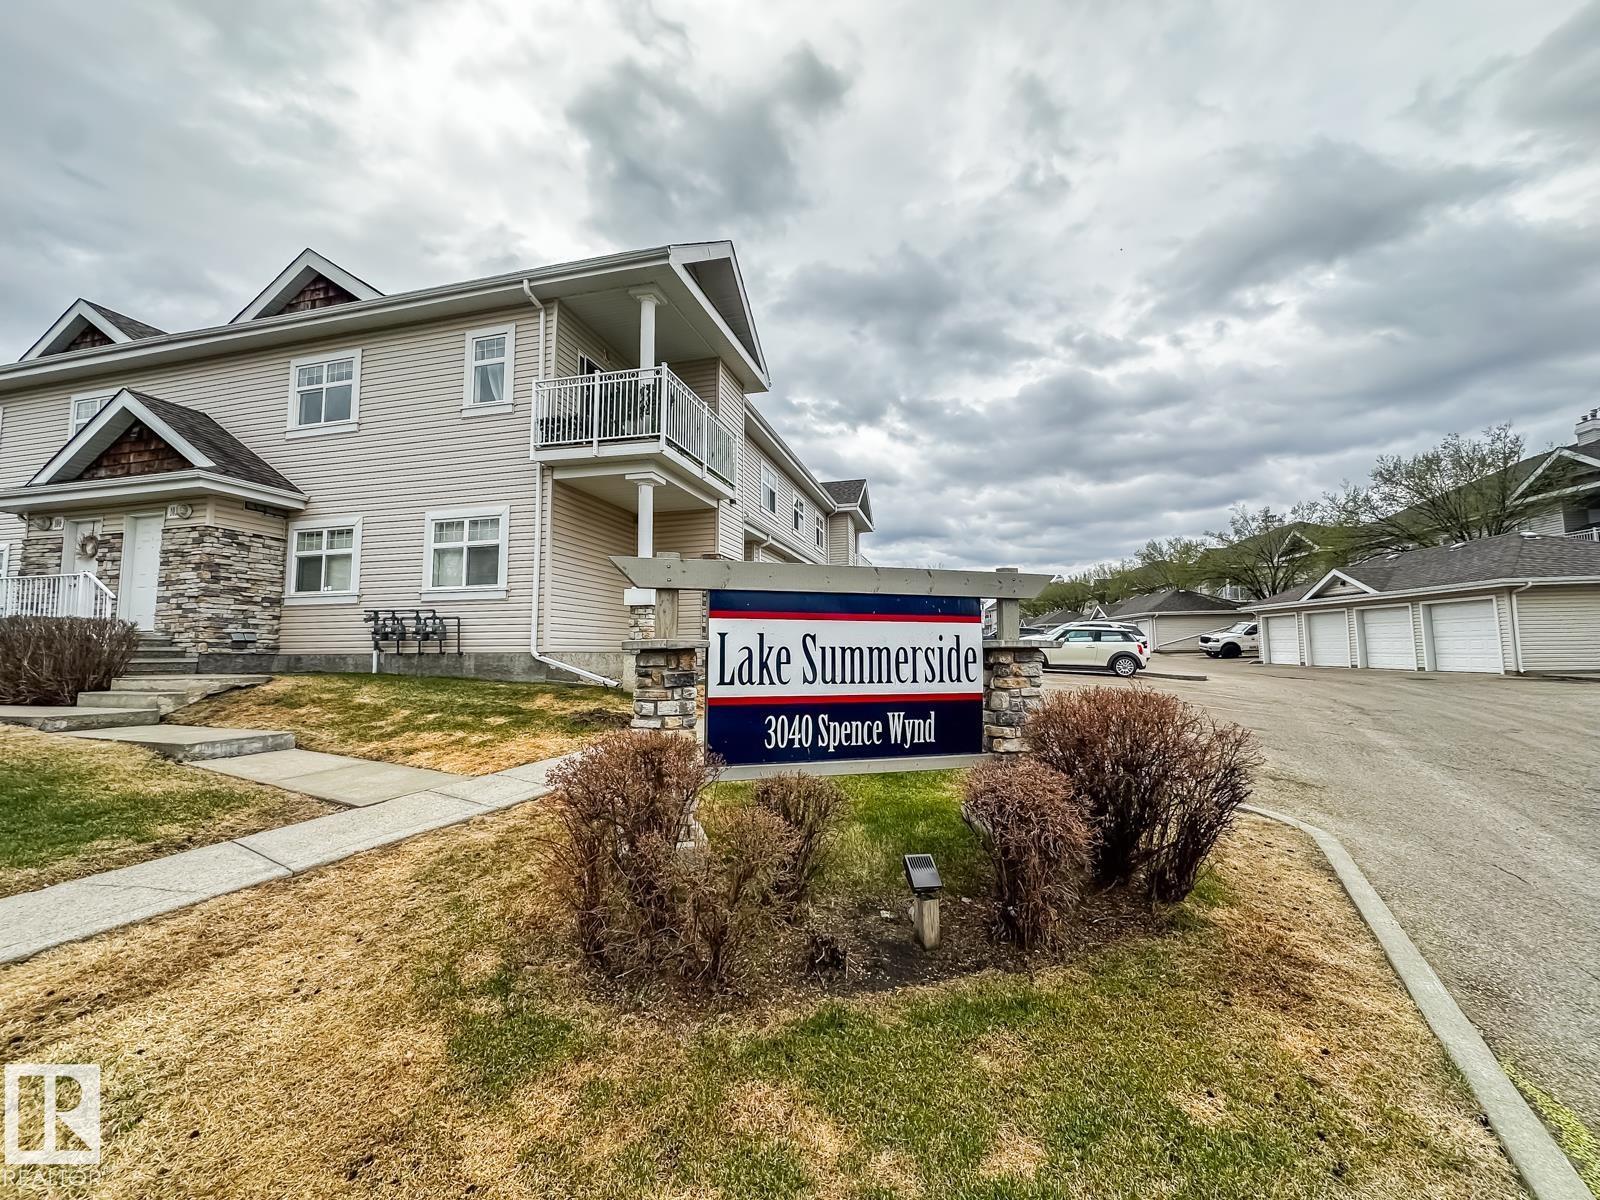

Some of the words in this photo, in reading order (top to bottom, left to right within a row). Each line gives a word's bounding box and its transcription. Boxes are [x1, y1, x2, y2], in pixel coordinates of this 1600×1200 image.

[716, 632, 791, 686] Lake
[801, 633, 977, 685] Summerside
[764, 714, 813, 749] 3040
[818, 714, 883, 752] Spence
[887, 711, 936, 749] Wynd
